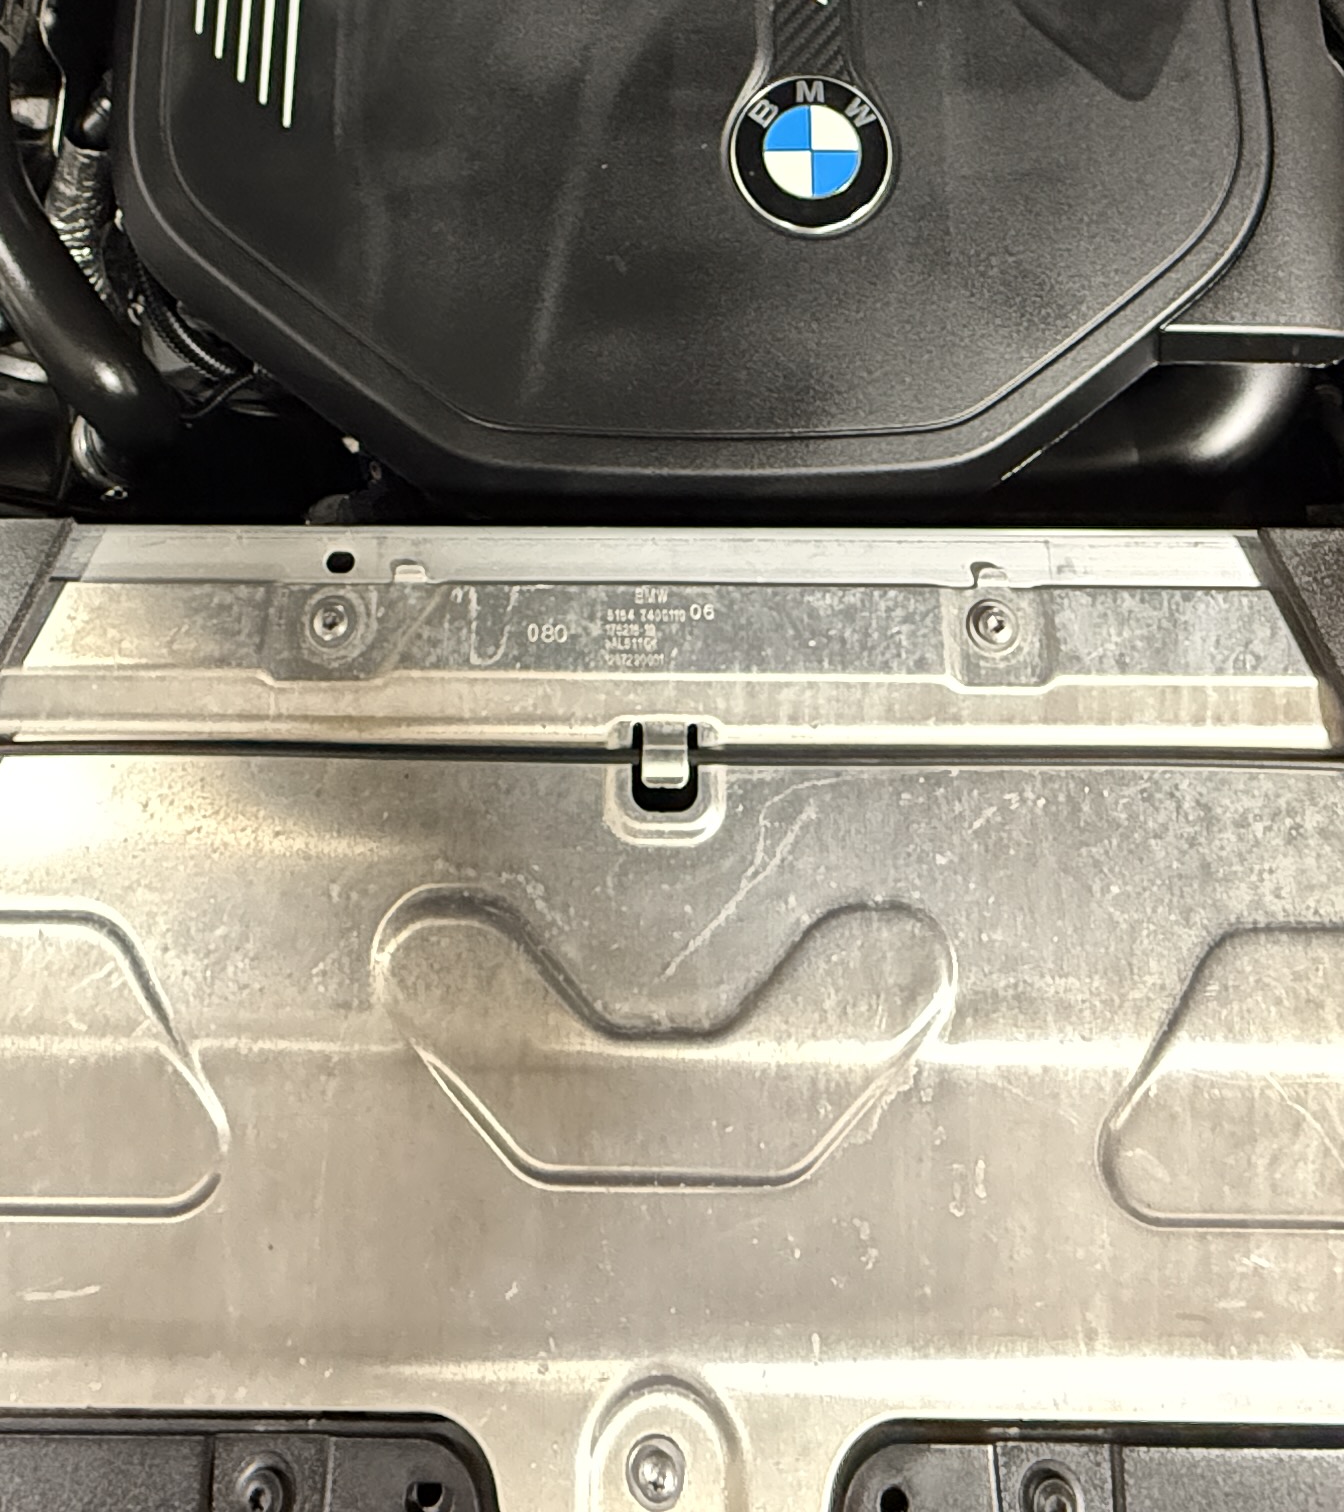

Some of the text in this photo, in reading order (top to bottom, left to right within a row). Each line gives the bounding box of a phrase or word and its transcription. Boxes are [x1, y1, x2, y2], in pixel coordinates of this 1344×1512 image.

[747, 80, 877, 129] BMW
[634, 587, 669, 604] BMW
[689, 603, 716, 621] 06
[527, 623, 568, 643] 080
